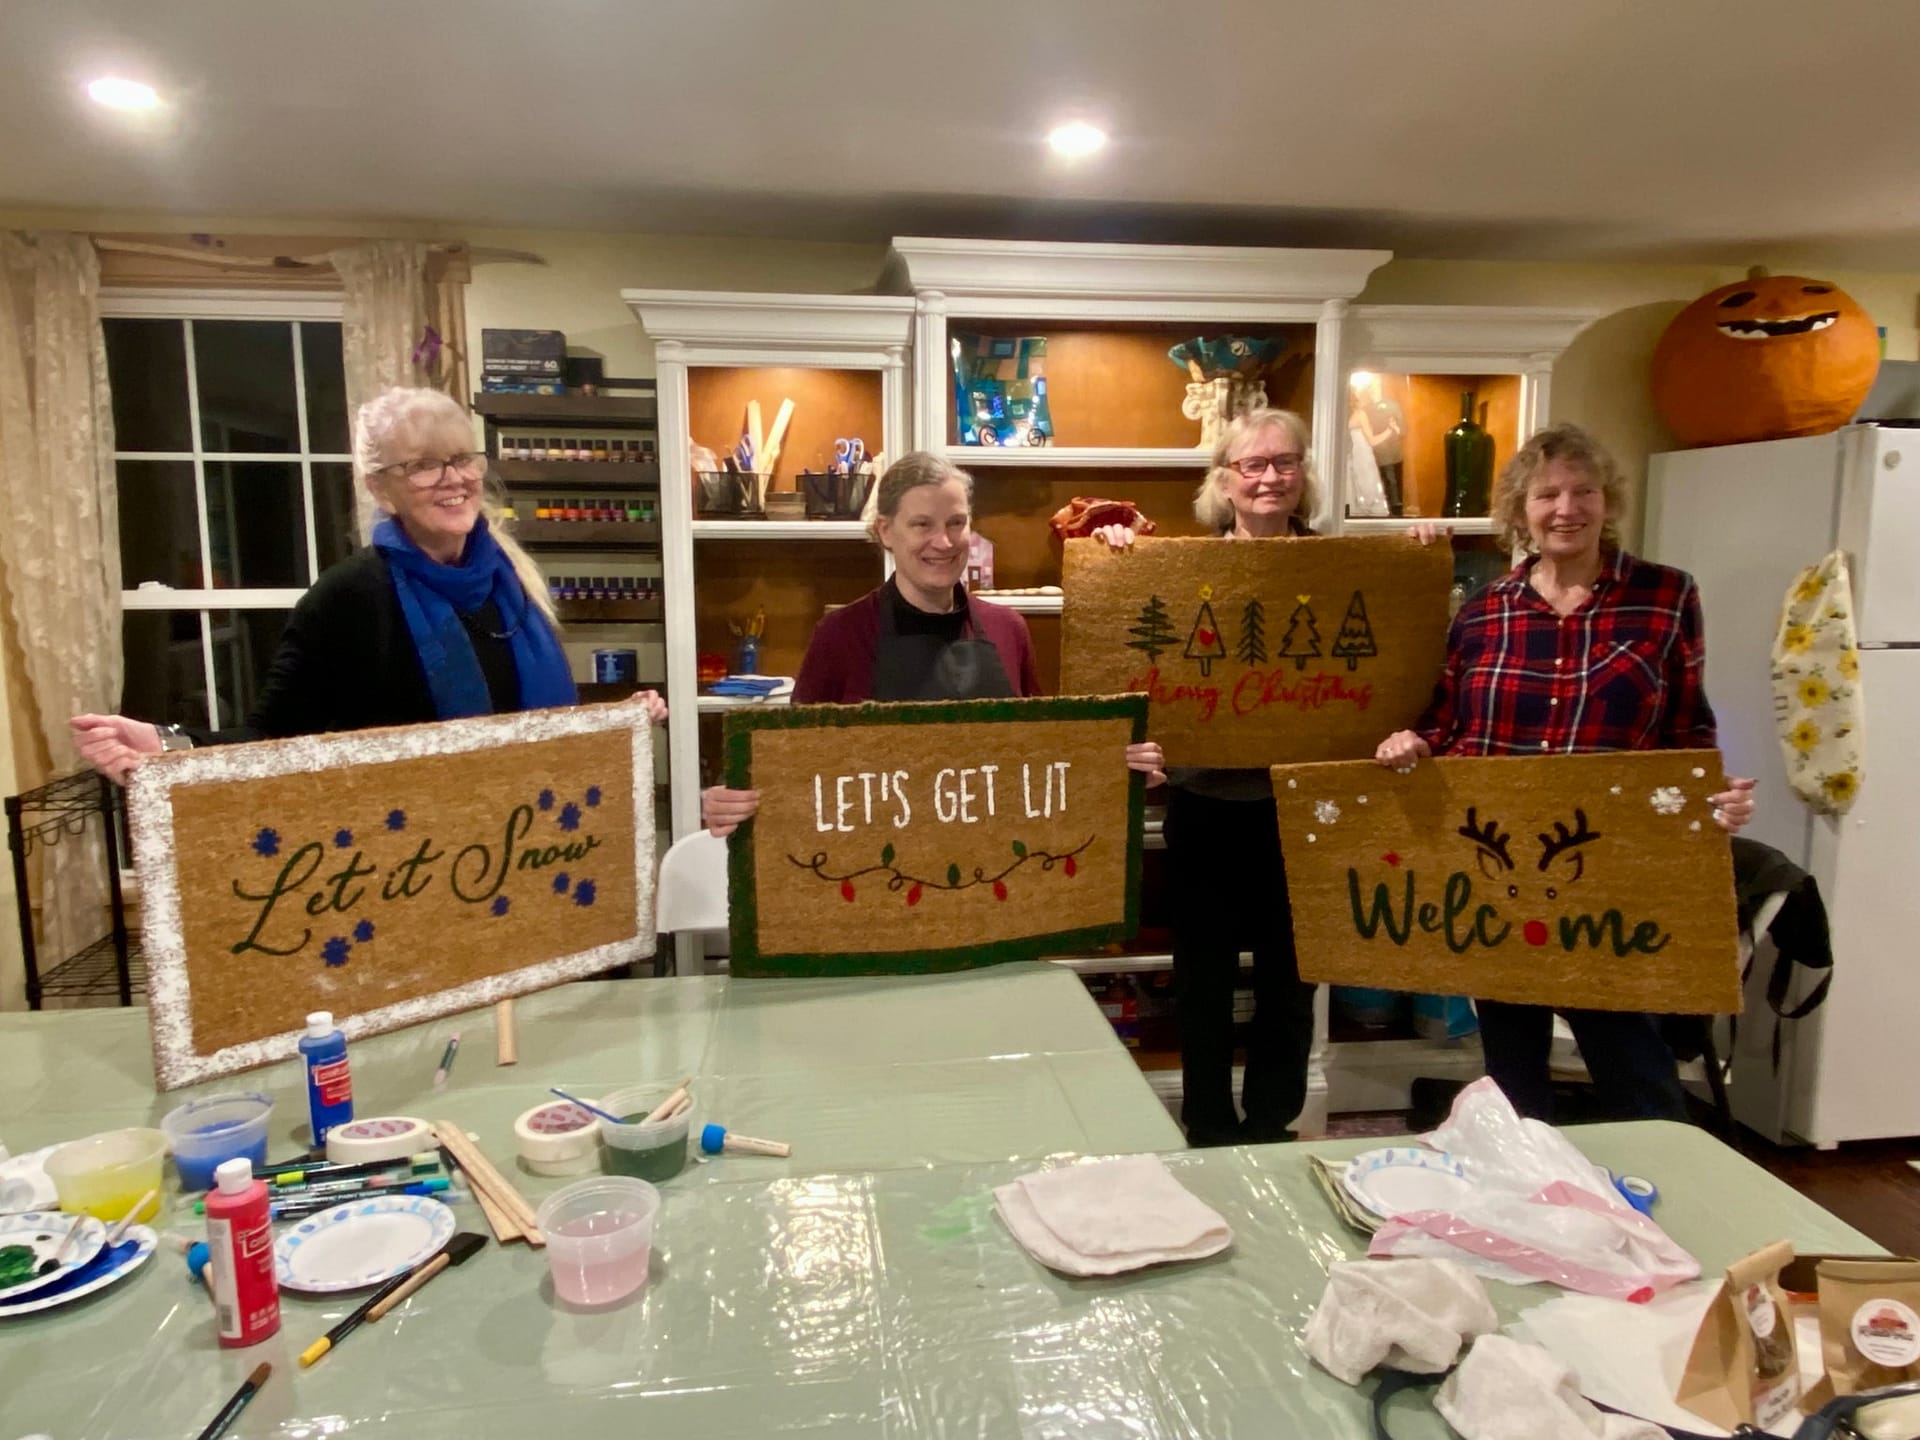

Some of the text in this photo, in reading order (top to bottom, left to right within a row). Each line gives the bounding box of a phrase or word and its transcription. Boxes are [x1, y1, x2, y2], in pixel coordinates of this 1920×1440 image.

[814, 761, 1071, 832] LET'S GET LIT
[231, 804, 602, 956] Let it Snow
